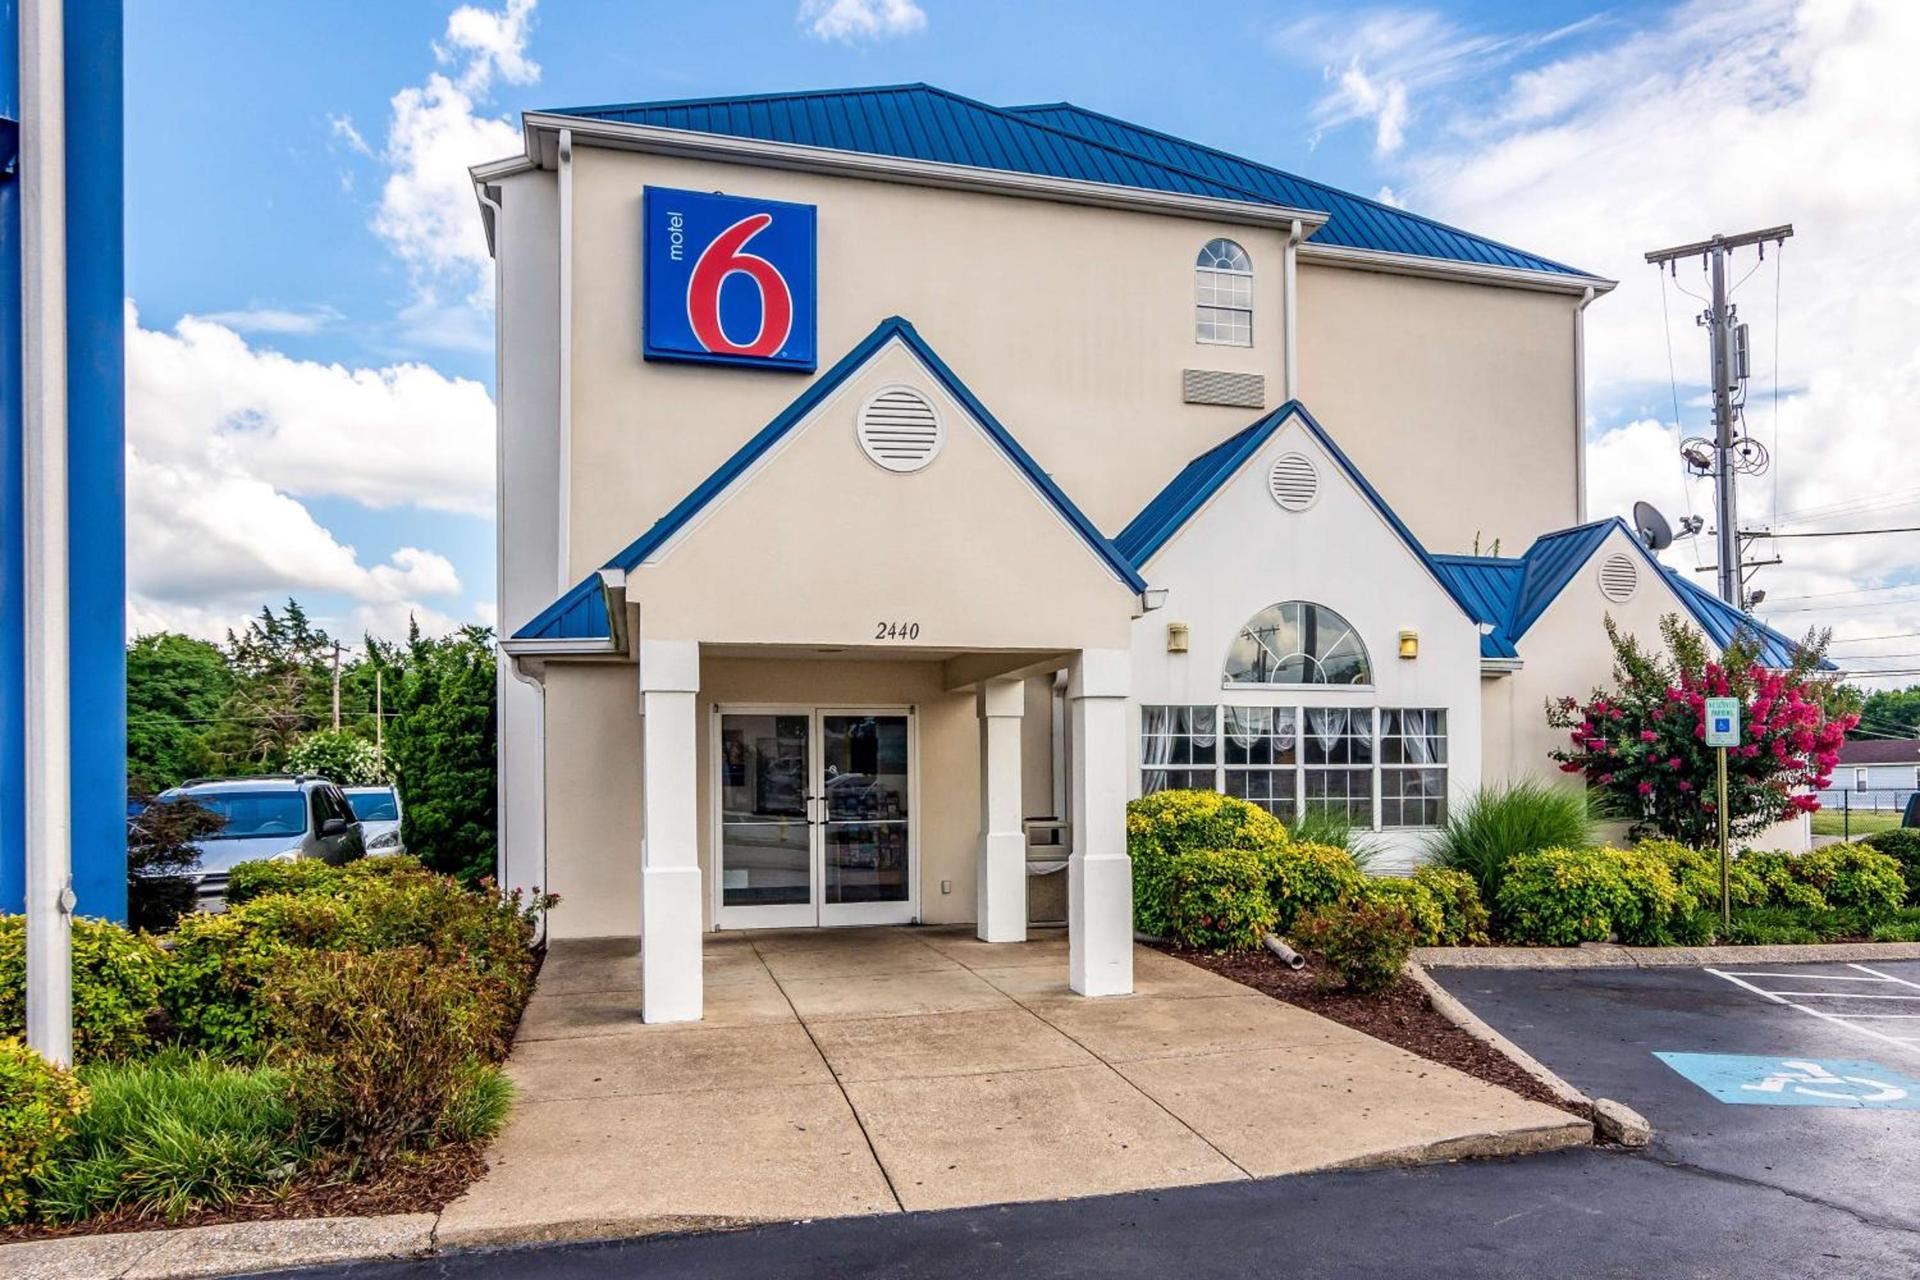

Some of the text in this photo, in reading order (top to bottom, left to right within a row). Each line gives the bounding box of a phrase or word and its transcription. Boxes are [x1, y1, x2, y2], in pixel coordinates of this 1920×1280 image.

[667, 211, 793, 358] motel 6
[875, 621, 920, 640] 2440
